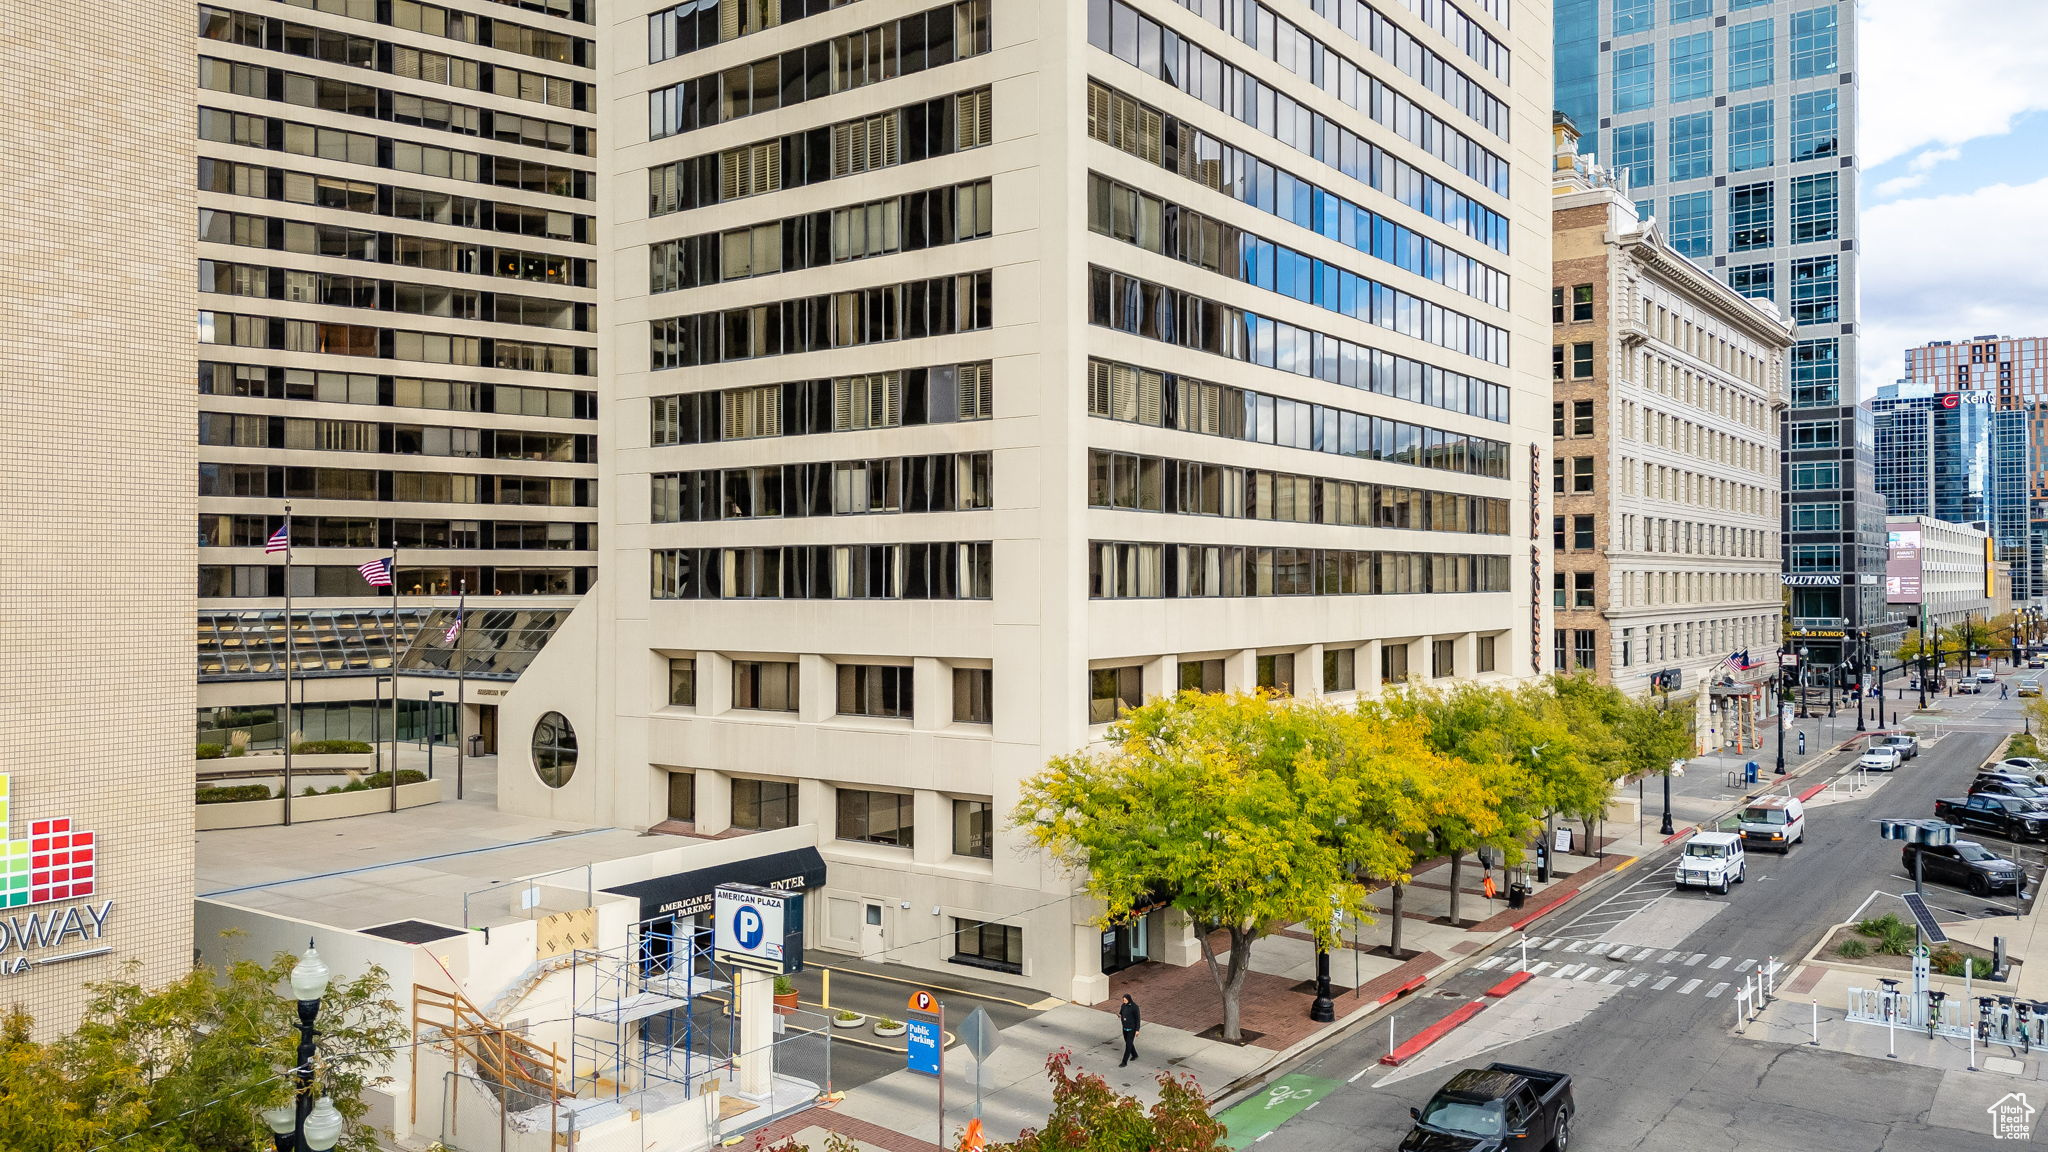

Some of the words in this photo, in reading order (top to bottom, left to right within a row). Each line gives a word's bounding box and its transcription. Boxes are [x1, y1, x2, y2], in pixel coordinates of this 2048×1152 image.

[1530, 442, 1541, 541] TOWERS
[1530, 544, 1541, 674] AMERICAN
[770, 876, 805, 889] ENTER
[659, 896, 703, 913] AMERICAN
[704, 893, 714, 903] PL
[717, 891, 756, 904] AMERICAN
[757, 898, 782, 909] PLAZA
[678, 902, 712, 918] PARKING
[740, 910, 759, 943] P
[909, 1023, 930, 1036] Public
[909, 1032, 935, 1049] Parking
